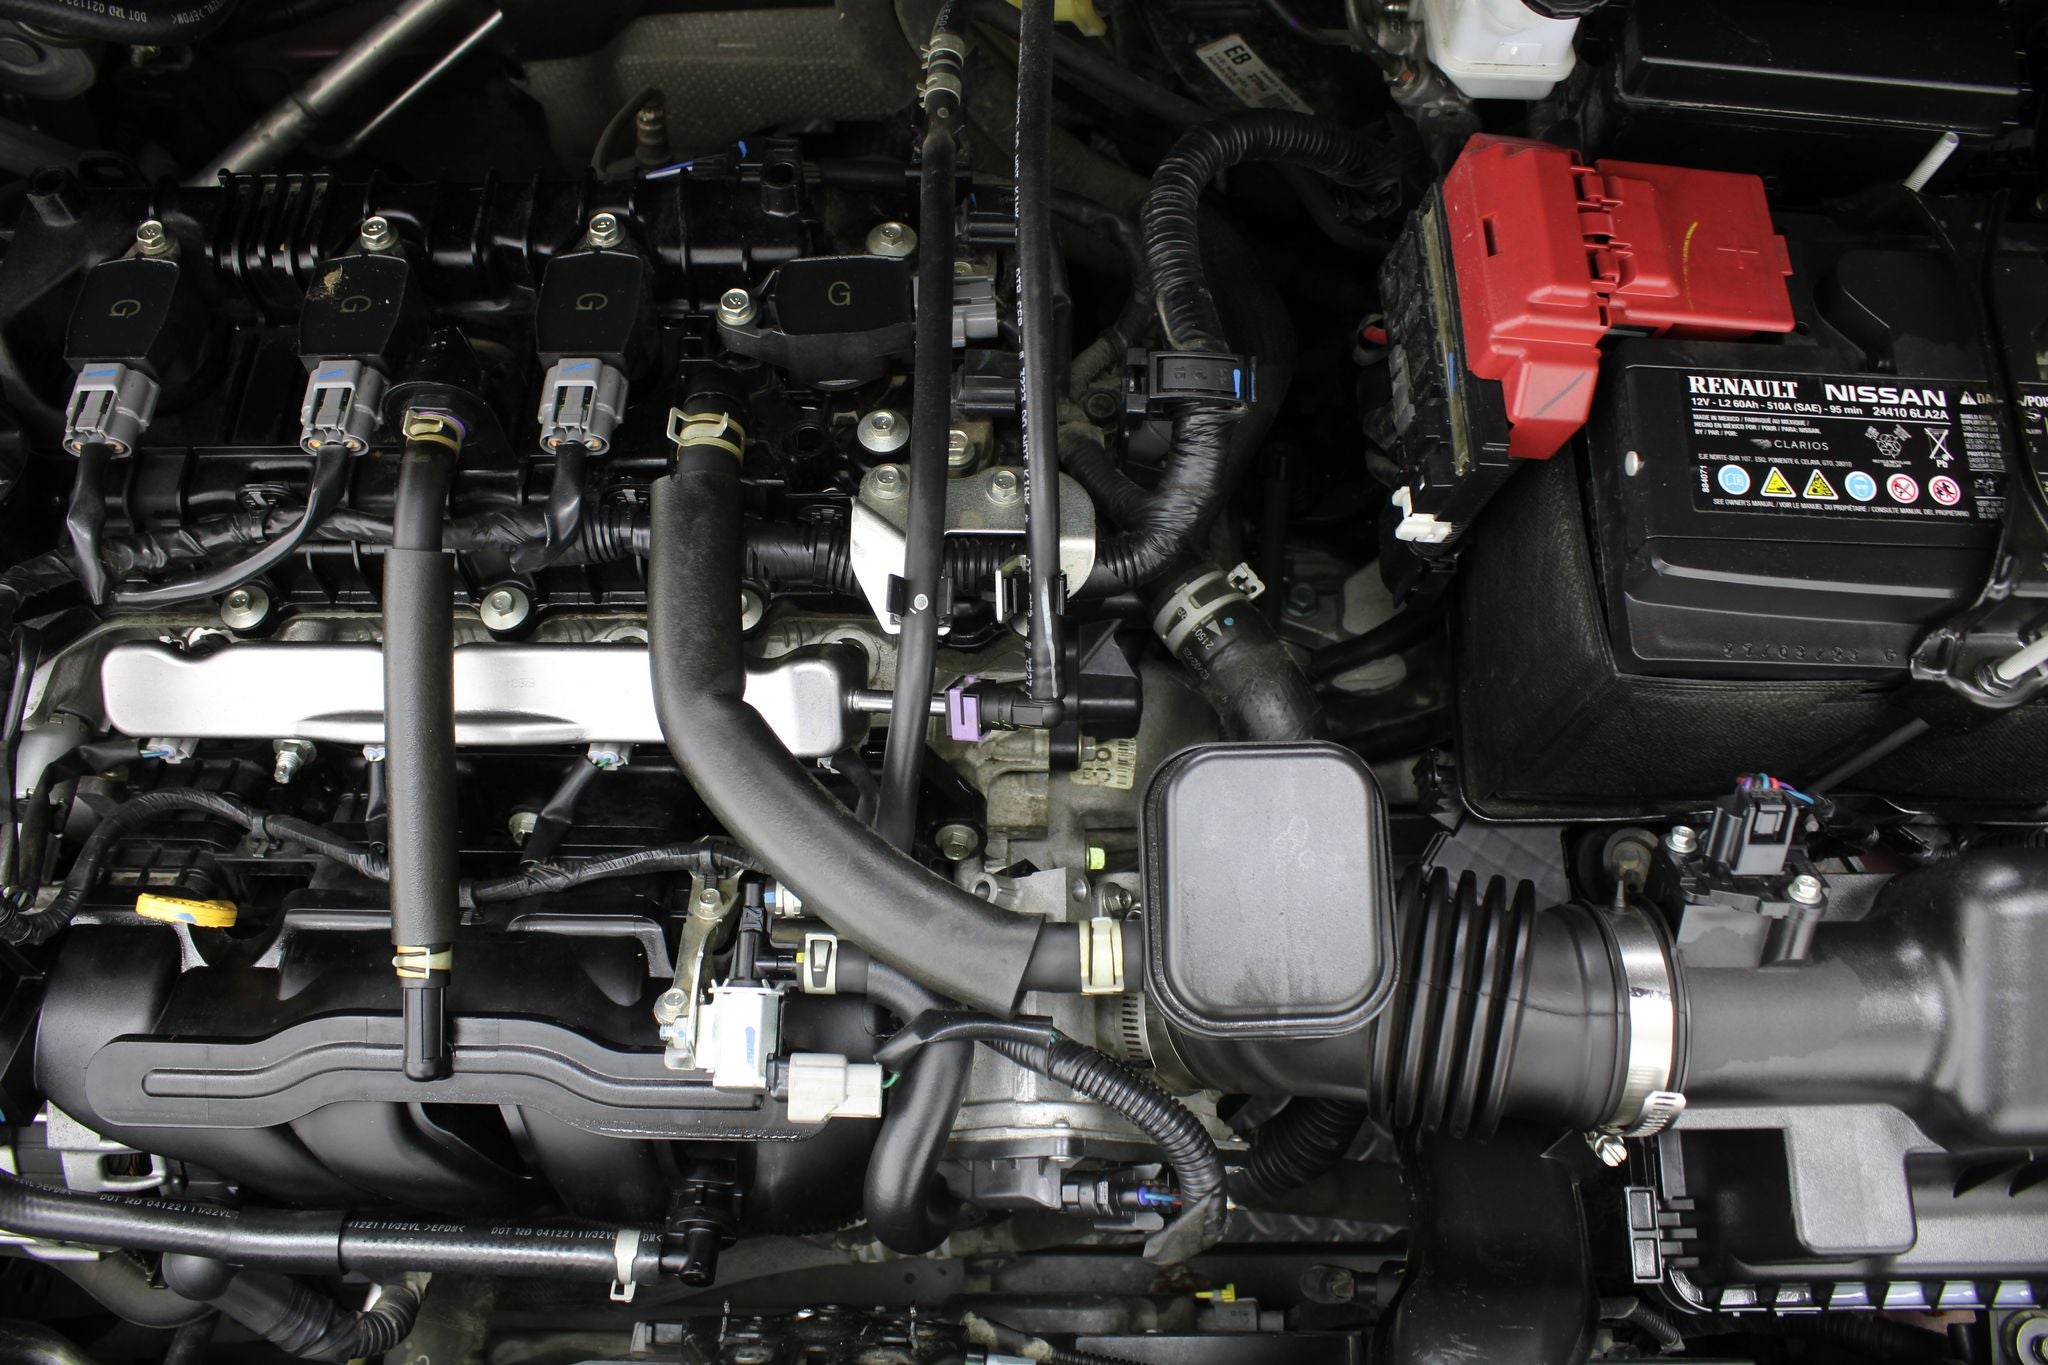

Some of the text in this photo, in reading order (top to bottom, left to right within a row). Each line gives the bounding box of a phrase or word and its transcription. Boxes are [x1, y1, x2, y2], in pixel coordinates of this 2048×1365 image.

[129, 10, 147, 24] DOT
[1224, 45, 1252, 65] EB
[575, 292, 609, 311] G
[828, 281, 851, 306] G
[109, 299, 141, 317] G
[340, 295, 372, 313] G
[1687, 376, 1947, 407] RENAULT NISSAN
[1691, 398, 1710, 407] 12V
[1718, 399, 1732, 408] L2
[1733, 400, 1759, 409] 60Ah
[1767, 402, 1792, 411] 510A
[1793, 403, 1822, 414] (SAE)
[1829, 405, 1842, 414] 95
[1844, 406, 1863, 415] min
[1872, 406, 1907, 417] 24410
[1909, 408, 1949, 420] 6LA2A
[1773, 440, 1829, 451] CLARIOS
[1936, 460, 1949, 468] Pb
[346, 1221, 379, 1229] 41221
[491, 1226, 512, 1235] DOT
[536, 1228, 575, 1238] 041221
